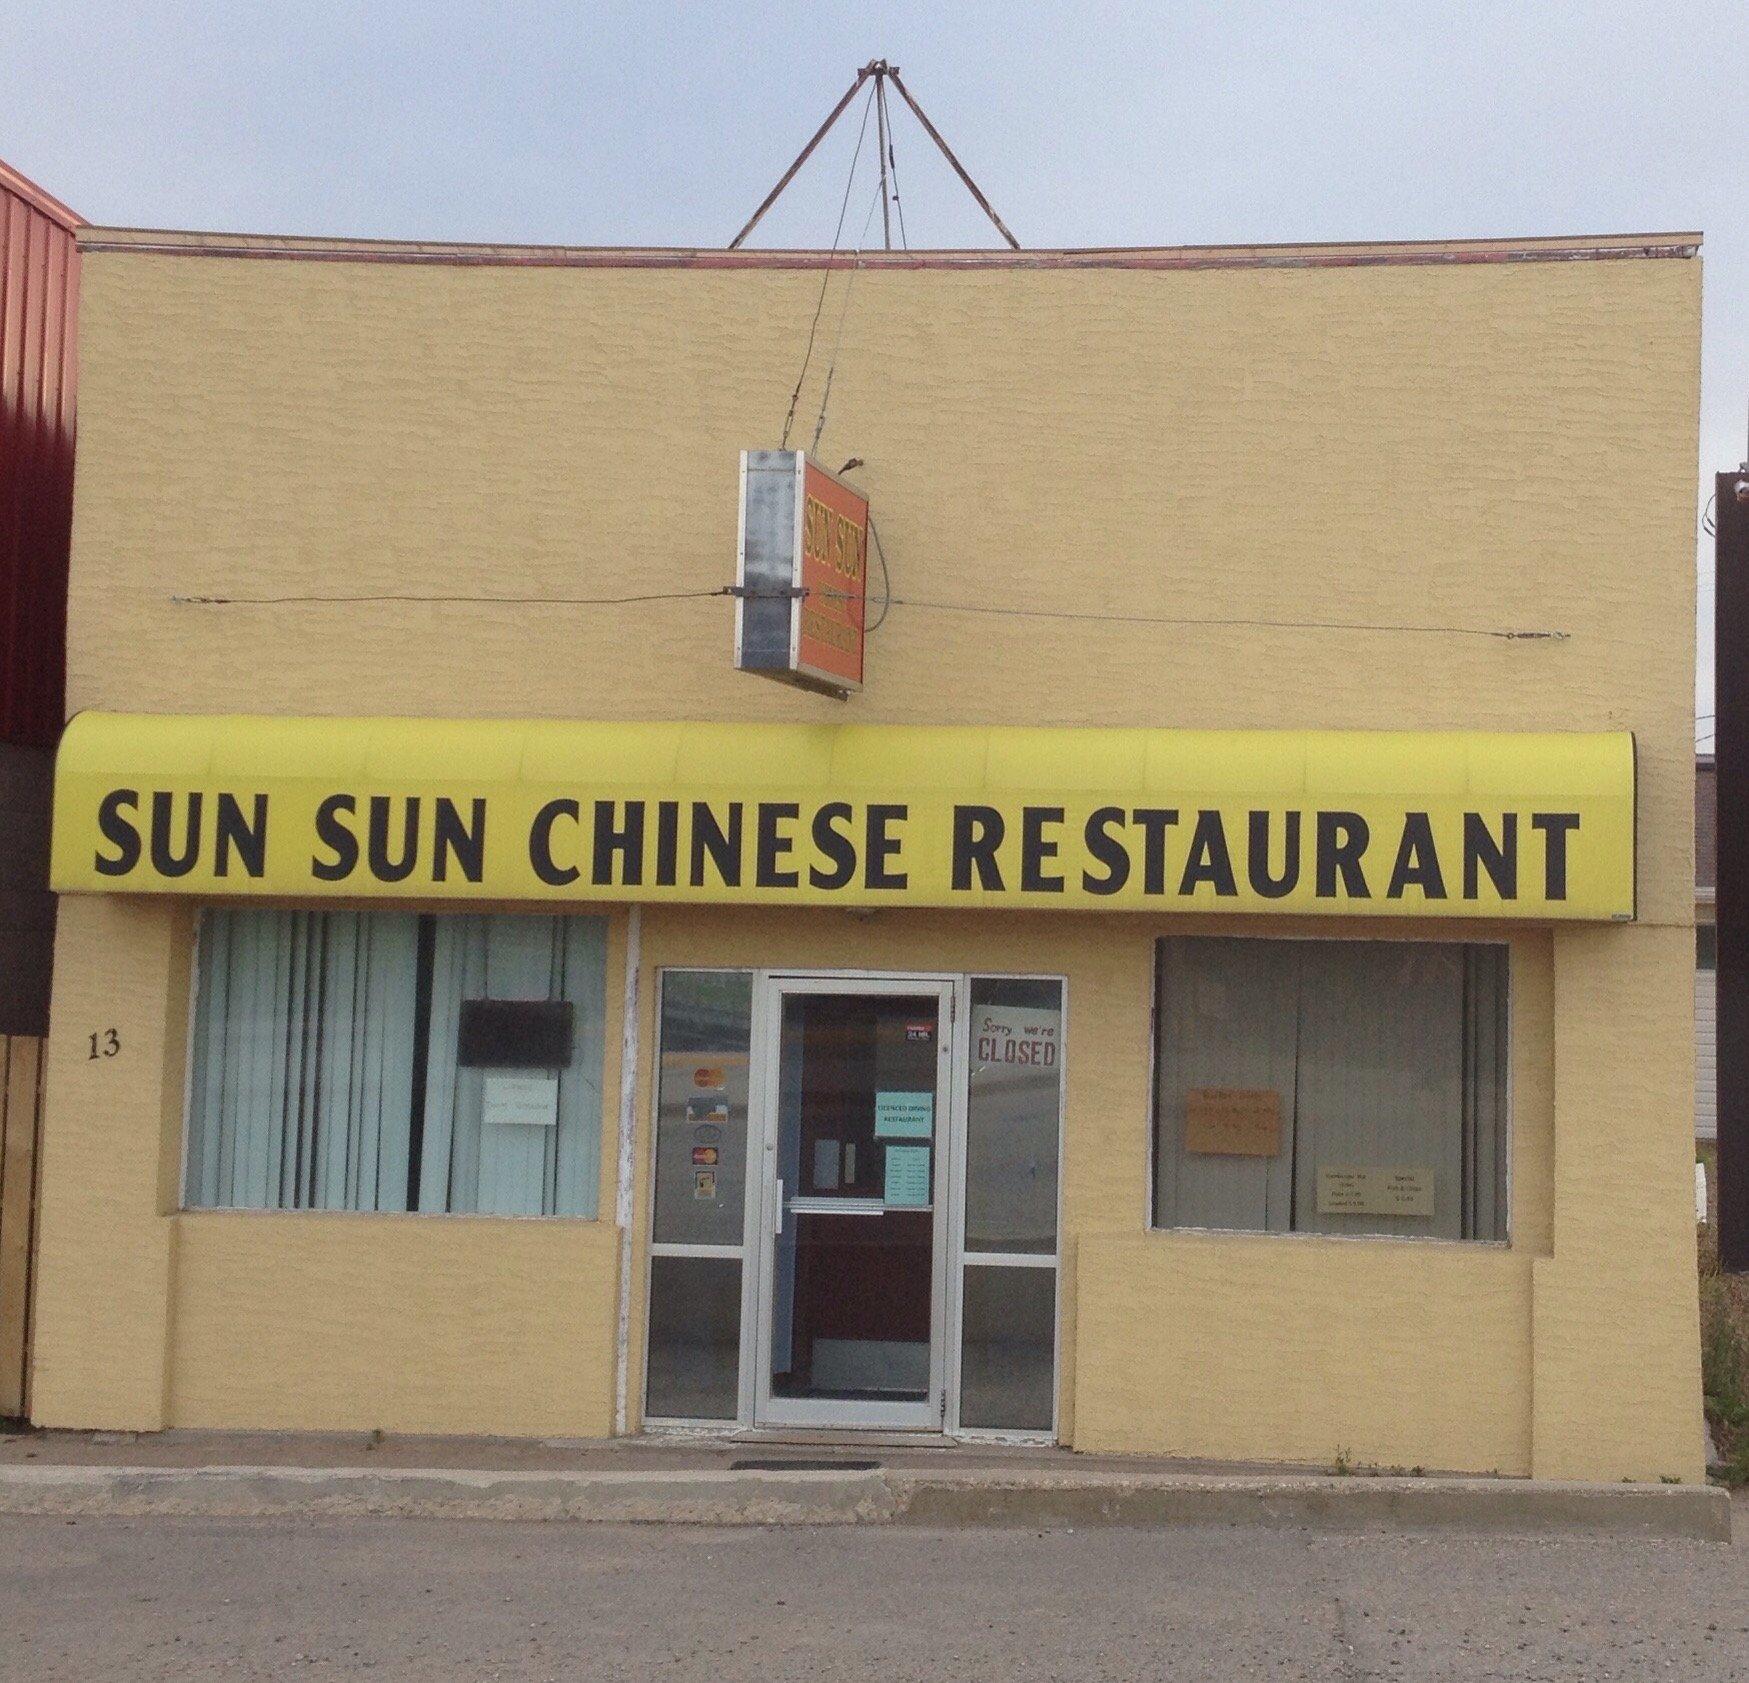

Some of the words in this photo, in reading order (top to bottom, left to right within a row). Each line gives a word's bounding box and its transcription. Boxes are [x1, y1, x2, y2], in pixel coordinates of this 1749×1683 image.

[804, 492, 832, 567] SUN
[835, 513, 864, 582] SUN
[94, 788, 269, 878] SUN
[311, 793, 487, 883] SUN
[528, 798, 908, 893] CHINESE
[951, 804, 1580, 901] RESTAURANT
[983, 1017, 1013, 1036] Sorry
[1024, 1025, 1054, 1036] we're
[88, 1028, 120, 1060] 13
[978, 1036, 1056, 1067] CLOSED
